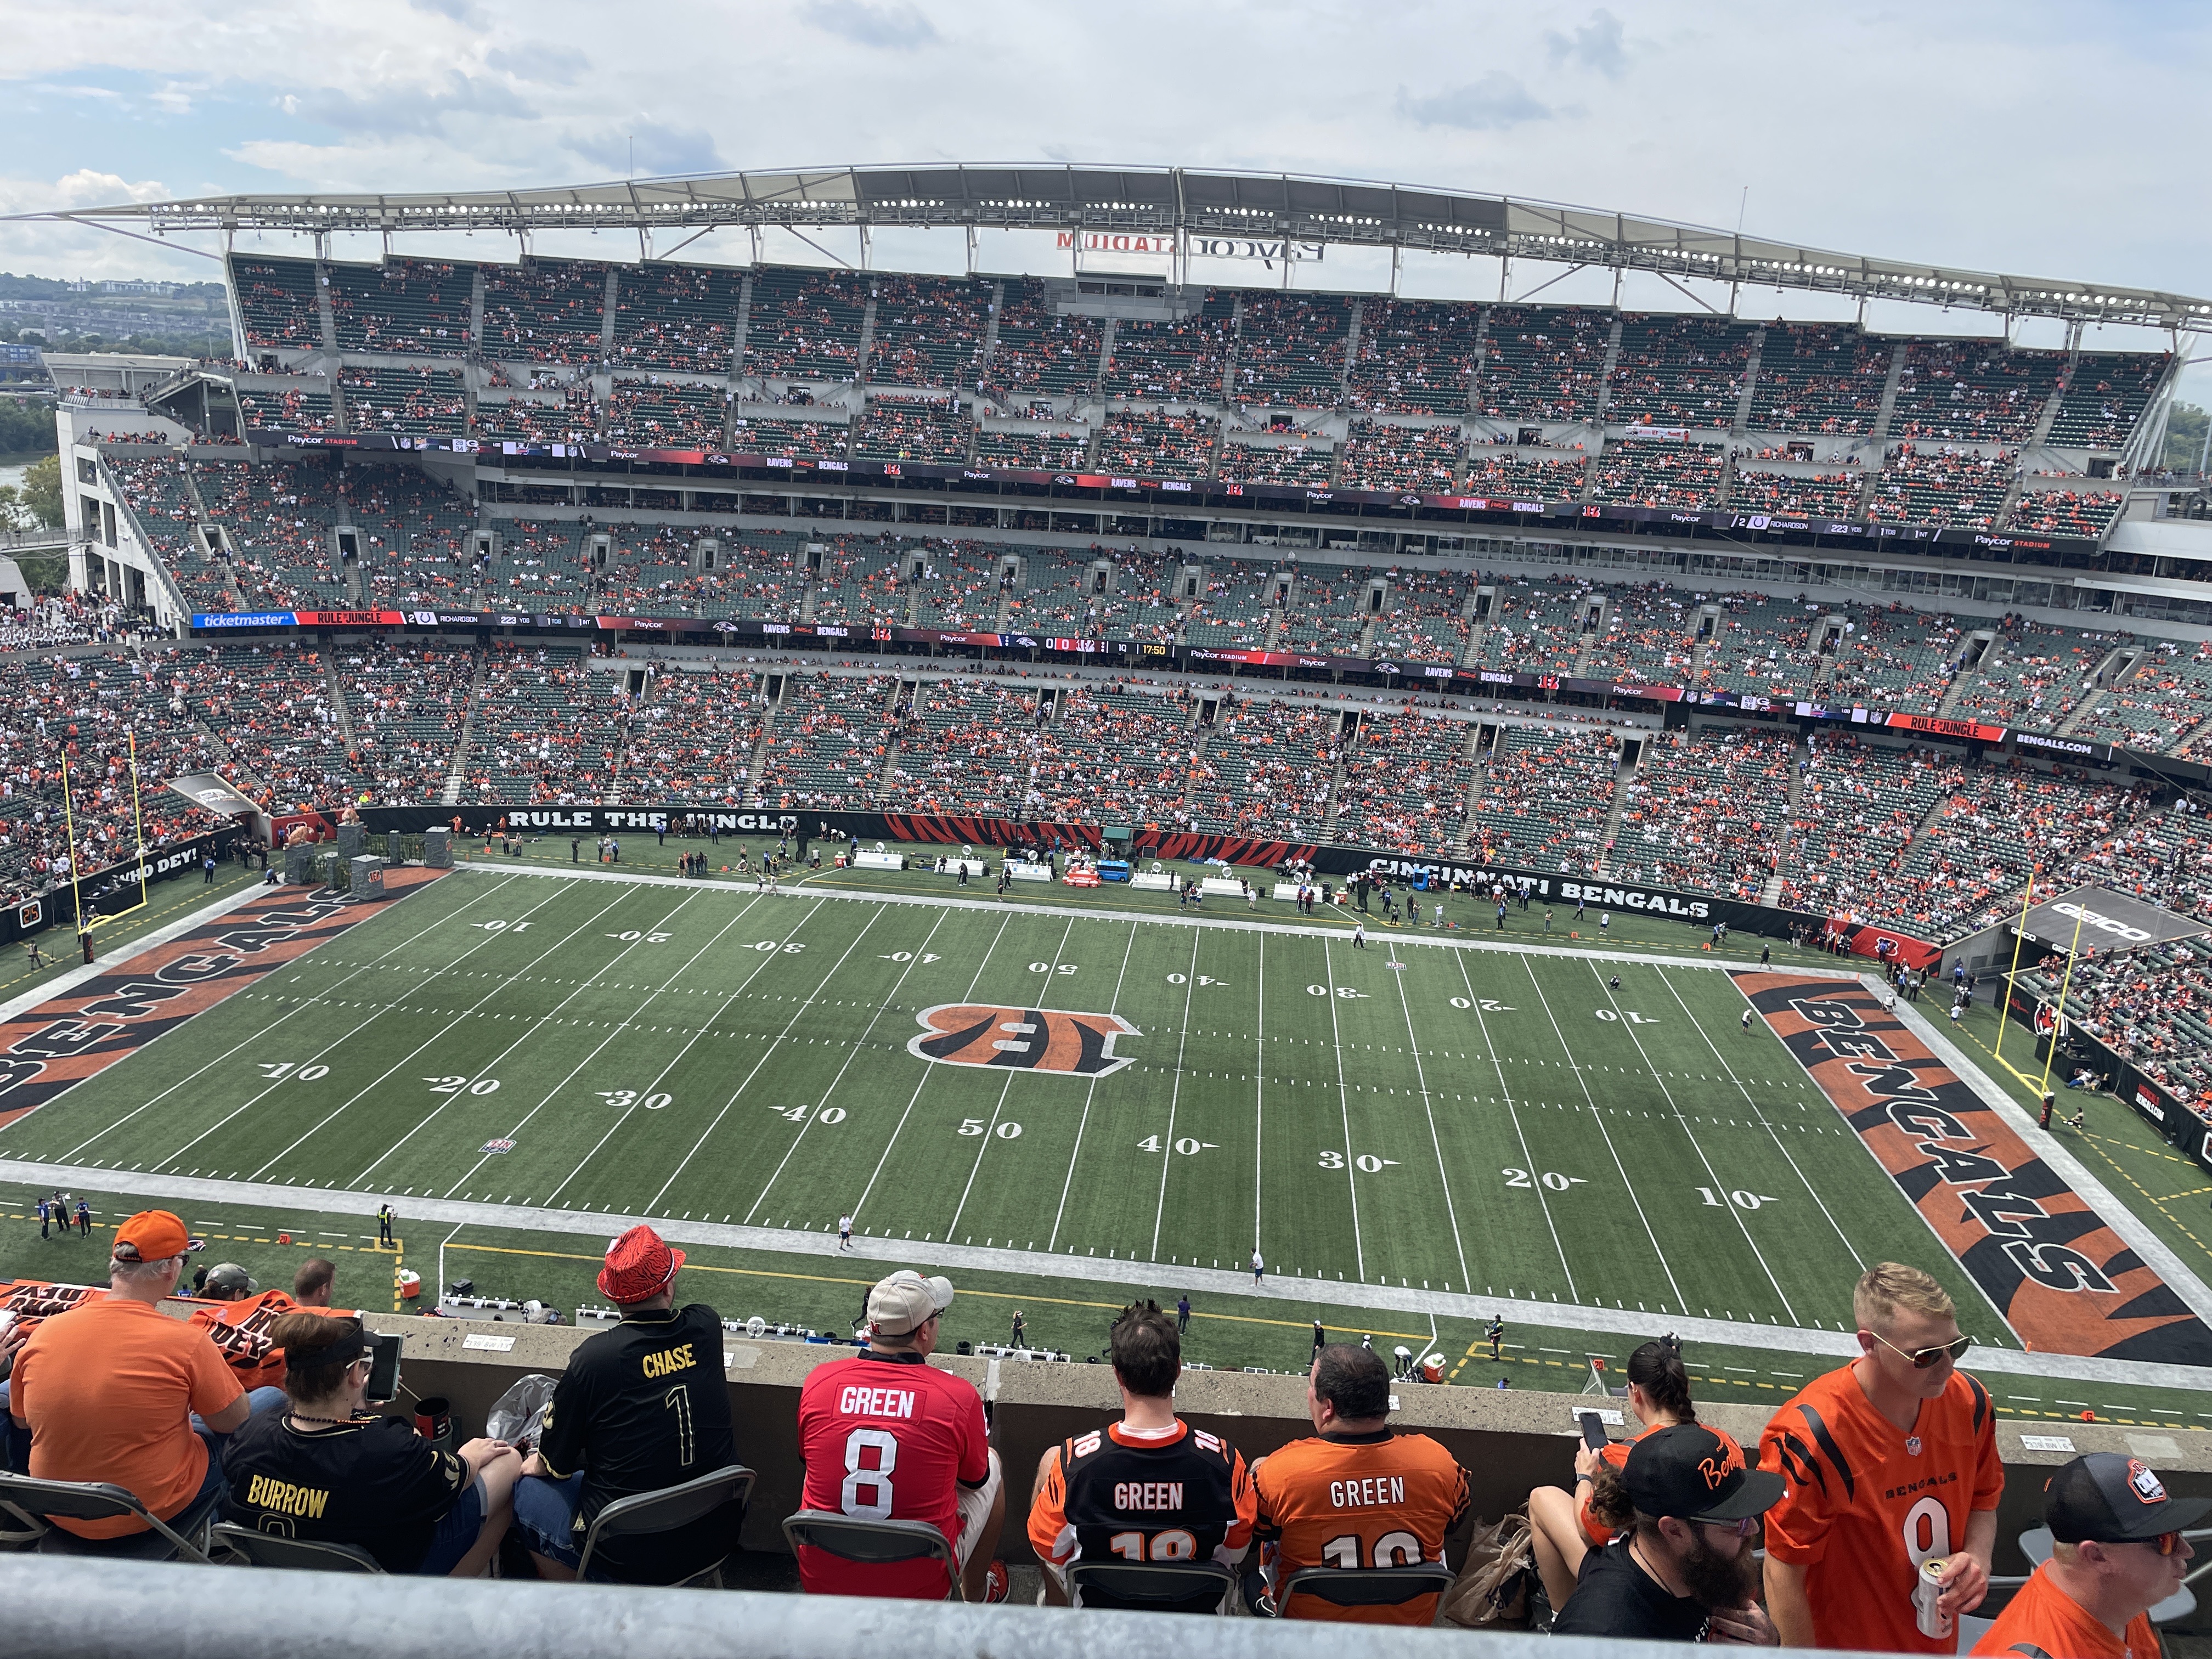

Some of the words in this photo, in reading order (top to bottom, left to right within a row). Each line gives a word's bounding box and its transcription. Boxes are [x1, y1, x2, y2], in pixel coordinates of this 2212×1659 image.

[287, 435, 323, 445] Paycor
[611, 450, 639, 459] Paycor
[767, 458, 793, 467] RAVENS
[819, 460, 849, 471] BENGALS
[964, 471, 990, 479] Paycor
[1111, 478, 1136, 488] RAVENS
[1162, 481, 1192, 492] BENGALS
[1307, 490, 1333, 500] Paycor
[1459, 499, 1486, 509] RAVENS
[1513, 502, 1544, 513] BENGALS
[1671, 514, 1701, 523] Paycor
[1739, 518, 1745, 527] 2
[1770, 521, 1808, 530] RICHARDSON
[1831, 524, 1848, 533] 223
[1975, 534, 2013, 547] Paycor
[204, 614, 284, 627] ticketmaster
[318, 612, 342, 623] RULE
[346, 612, 382, 623] JUNGLE
[408, 614, 415, 623] 2
[634, 620, 663, 630] Paycor
[763, 624, 790, 634] RAVENS
[817, 626, 848, 636] BENGALS
[940, 634, 967, 643] Paycor
[1046, 638, 1053, 649] 0
[1062, 639, 1069, 650] 0
[1143, 645, 1165, 655] 17:50
[1190, 650, 1220, 659] Paycor
[1299, 658, 1328, 668] Paycor
[1425, 667, 1453, 678] RAVENS
[1480, 672, 1513, 684] BENGALS
[1612, 686, 1644, 696] Paycor
[1911, 716, 1936, 731] RULE
[1939, 721, 1979, 737] JUNGLE
[2017, 733, 2092, 754] BENGALS.COM
[508, 811, 592, 827] RULE
[605, 812, 667, 827] THE
[120, 865, 155, 883] WHO
[157, 847, 198, 874] DEY!
[1560, 882, 1709, 918] BENGALS
[24, 904, 38, 924] 25
[2051, 902, 2152, 941] GEICO
[2136, 1092, 2165, 1121] BENGALS.COM
[1788, 998, 2120, 1294] BENGALS
[642, 1344, 697, 1379] CHASE
[1438, 1368, 1443, 1377] G
[840, 1386, 915, 1418] GREEN
[665, 1385, 695, 1466] 1
[841, 1429, 898, 1520] 8
[1330, 1476, 1405, 1508] GREEN
[1886, 1472, 1957, 1499] BENGALS
[247, 1474, 330, 1519] BURROW
[1114, 1482, 1183, 1510] GREEN
